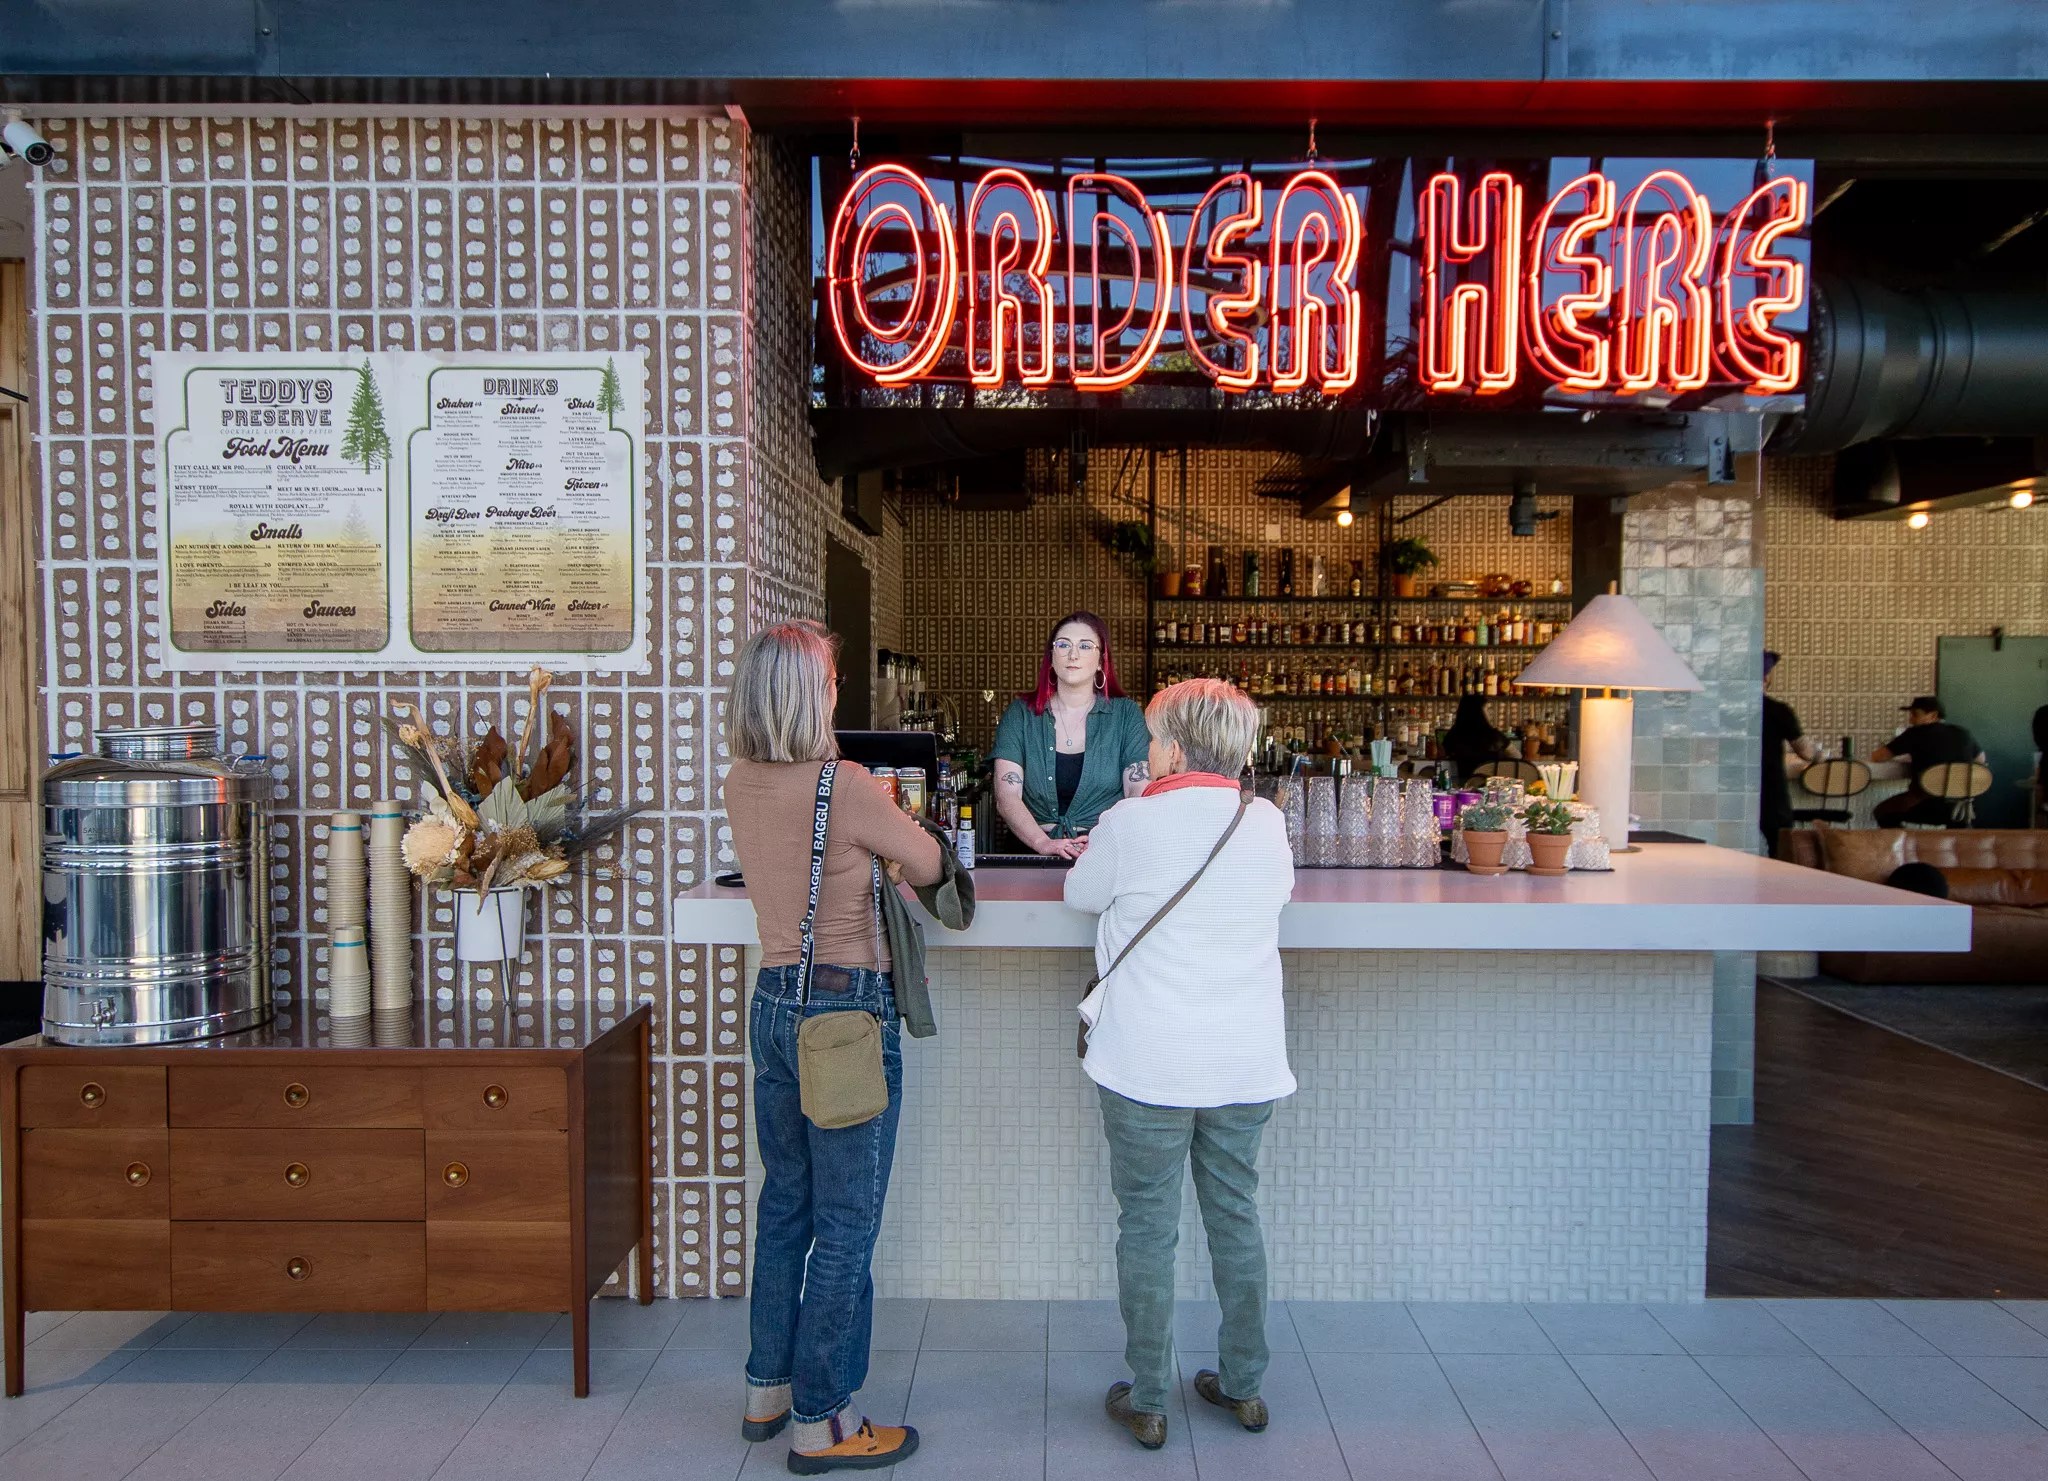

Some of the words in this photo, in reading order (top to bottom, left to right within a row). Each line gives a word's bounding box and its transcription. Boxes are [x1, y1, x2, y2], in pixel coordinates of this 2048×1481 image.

[829, 163, 1361, 393] ORDER
[1418, 170, 1804, 394] HERE
[219, 378, 332, 404] TEDDYS
[483, 377, 559, 396] DRINKS
[436, 397, 474, 410] Shaken
[500, 403, 538, 415] Stirred
[567, 397, 595, 410] Shots
[221, 409, 332, 427] PRESERVE
[222, 436, 271, 460] Food
[269, 436, 330, 464] Menu
[505, 458, 535, 471] Nitro
[564, 477, 600, 491] Frozen
[425, 507, 456, 523] Draft
[455, 507, 480, 520] Beer
[485, 505, 530, 520] Package
[530, 505, 557, 518] Beer
[250, 522, 303, 541] Smalls
[205, 599, 247, 619] Sides
[302, 599, 356, 619] Sauces
[489, 599, 529, 612] Canned
[528, 597, 556, 611] Wine
[567, 599, 601, 612] Seltzer
[818, 759, 839, 797] BAGG
[813, 802, 829, 851] BAGGU
[810, 855, 822, 904] BAGGU
